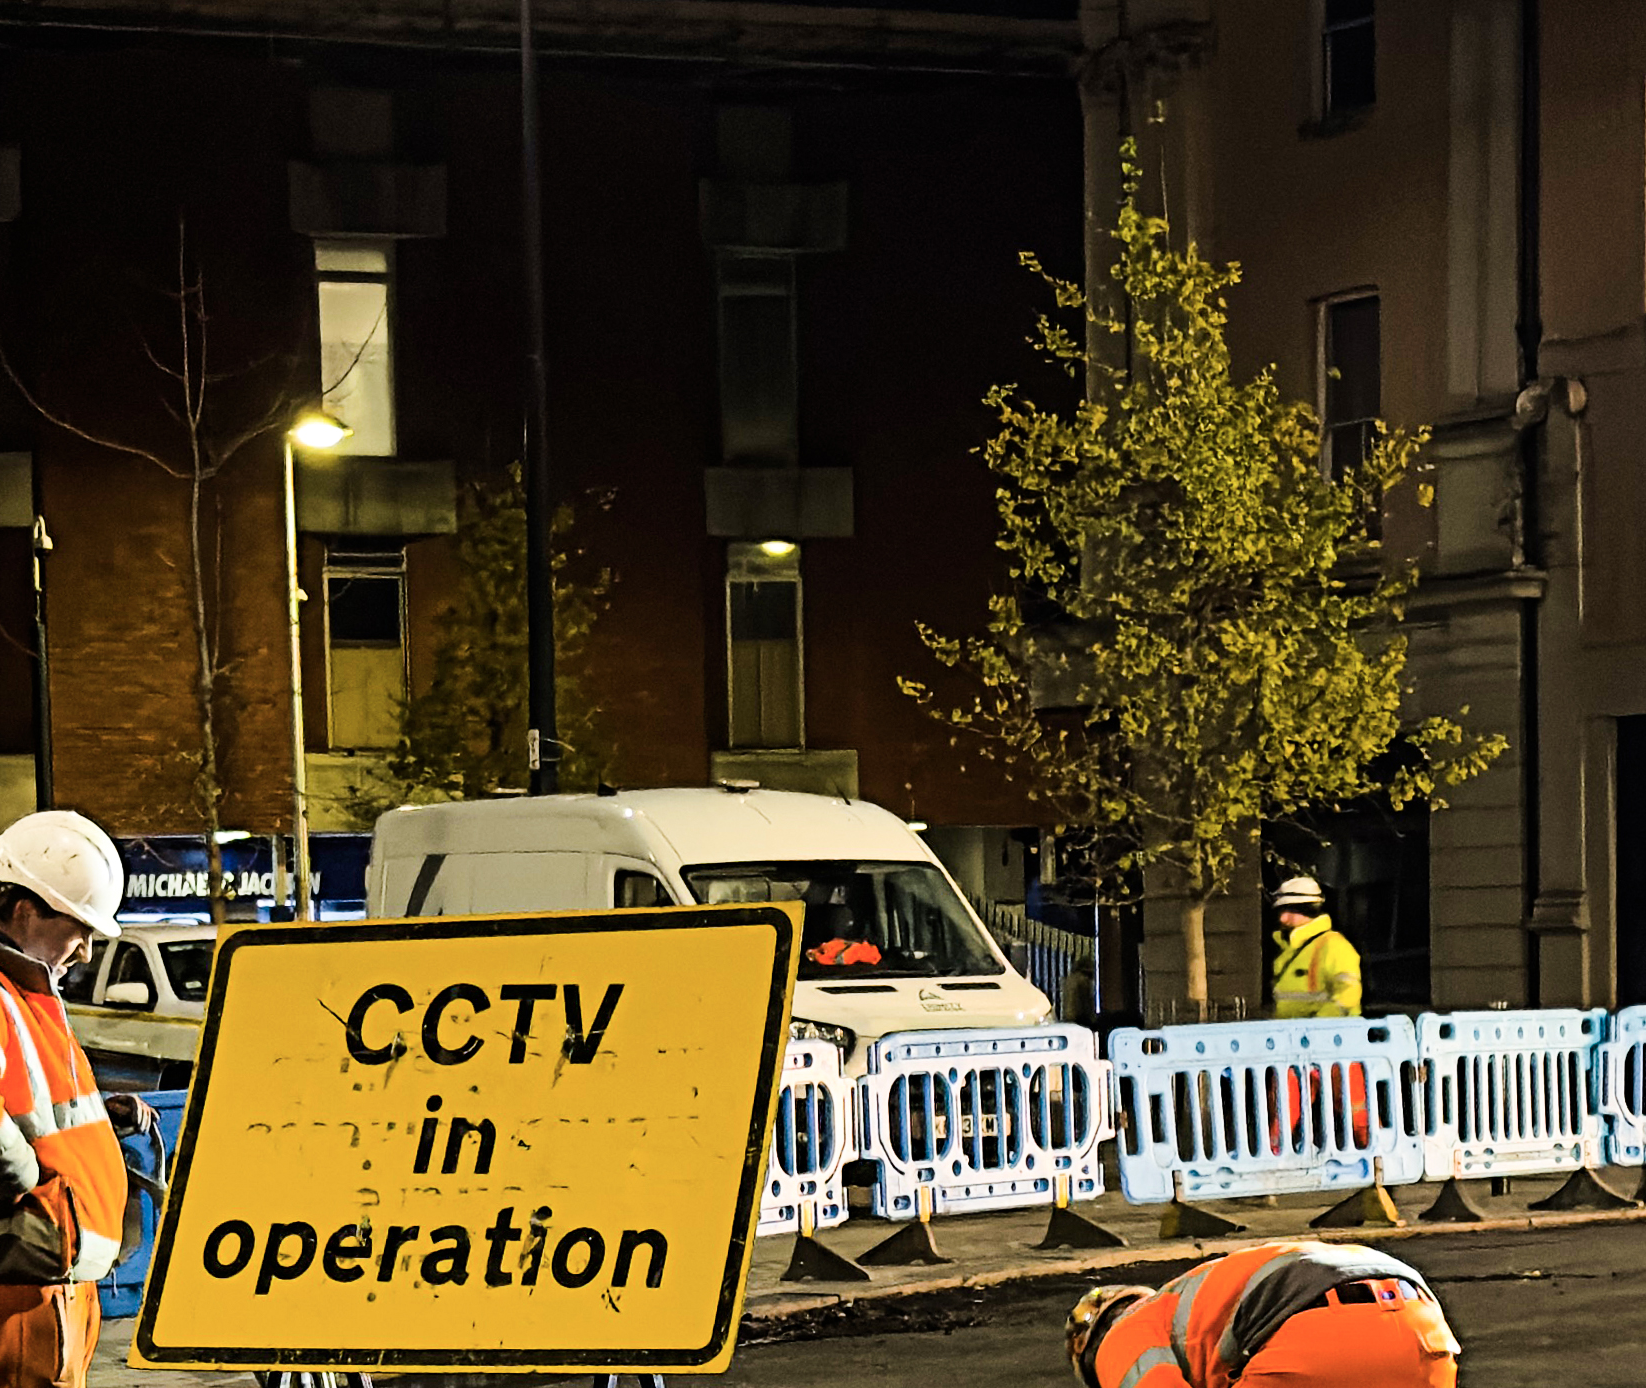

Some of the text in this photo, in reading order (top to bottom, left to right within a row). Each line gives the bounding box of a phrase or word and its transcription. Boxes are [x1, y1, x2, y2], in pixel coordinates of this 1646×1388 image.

[126, 871, 211, 897] MICHAE
[238, 871, 321, 896] JACN
[345, 983, 625, 1066] CCTV
[413, 1095, 497, 1175] in
[203, 1206, 669, 1296] operation
